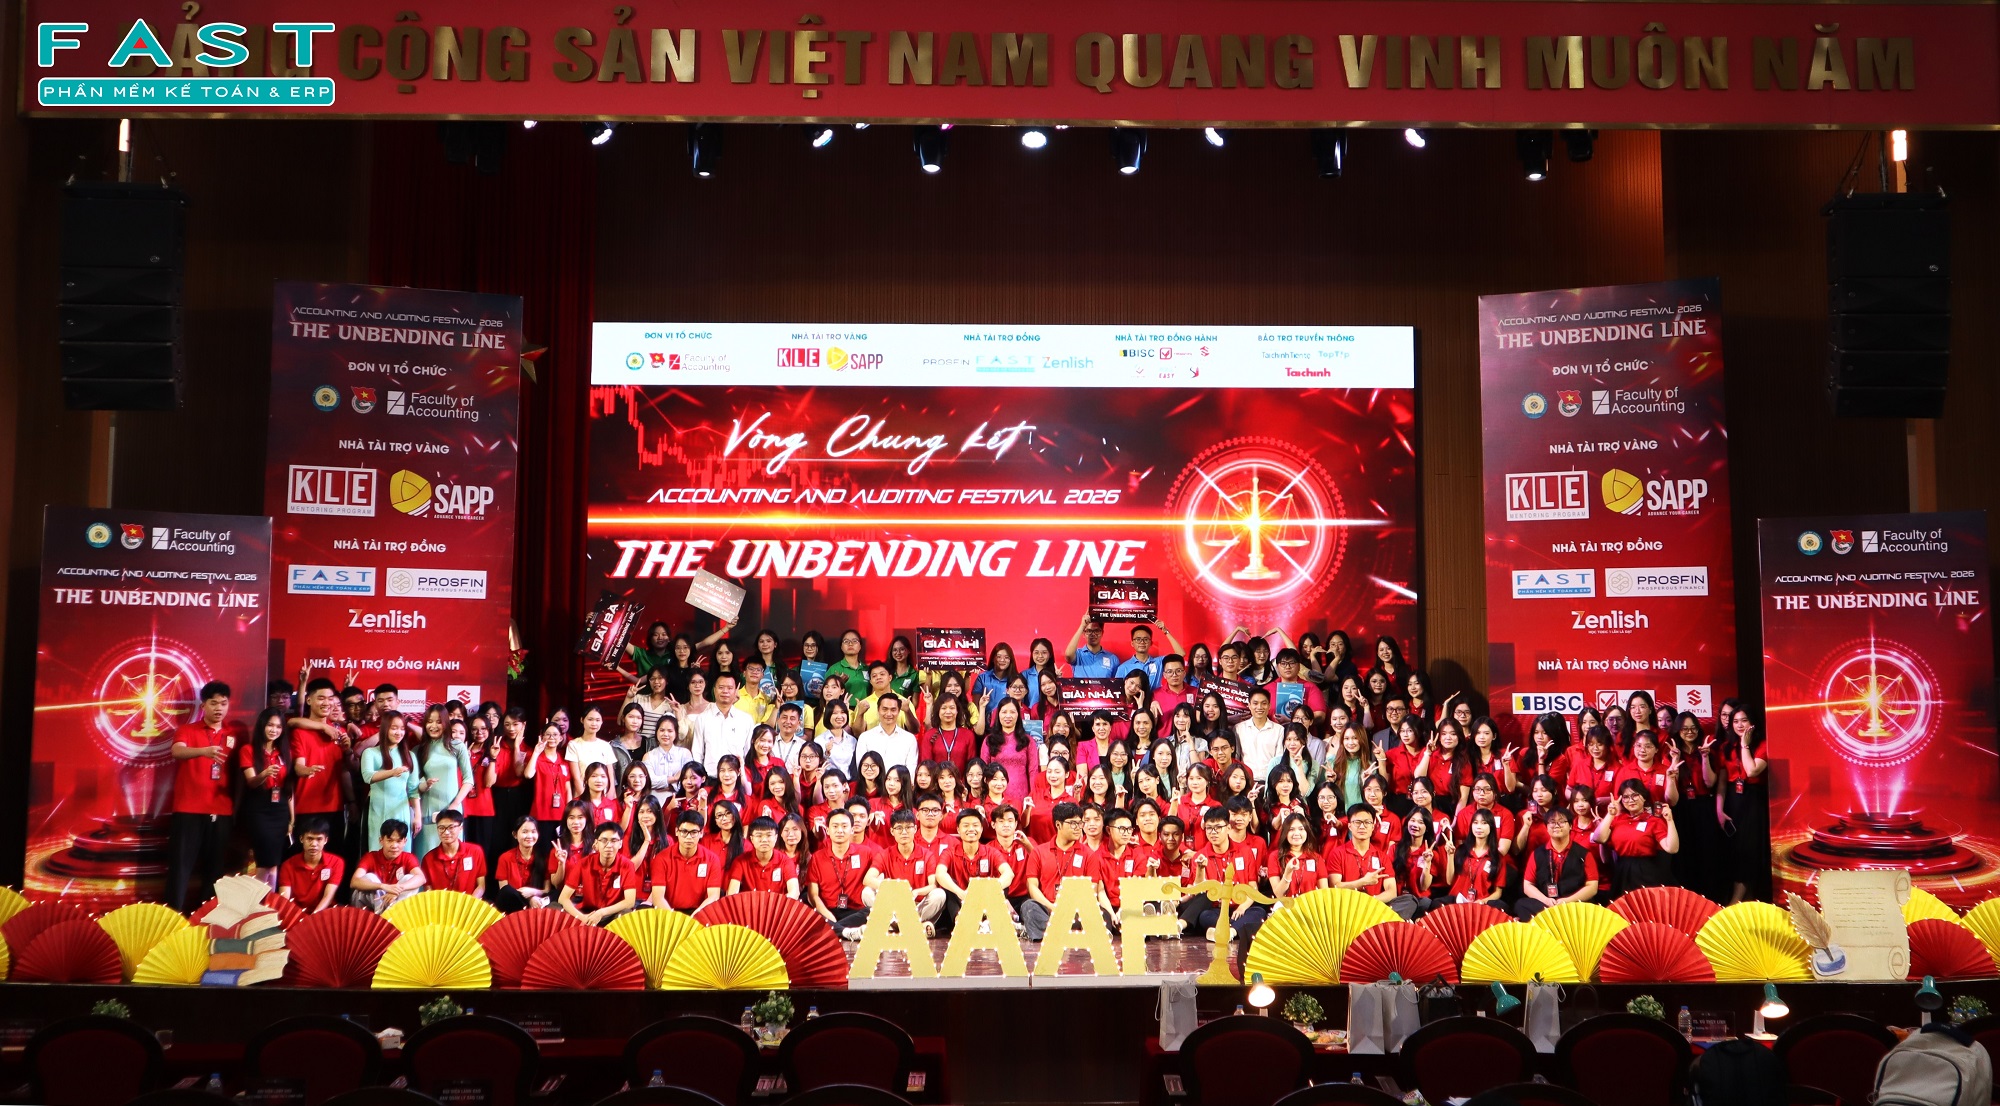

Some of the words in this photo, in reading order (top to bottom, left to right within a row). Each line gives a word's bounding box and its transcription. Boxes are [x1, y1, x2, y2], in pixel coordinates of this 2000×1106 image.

[337, 15, 529, 94] CỘNG
[551, 5, 695, 83] SẢN
[721, 15, 870, 98] VIỆT
[889, 31, 1048, 87] NAM
[1074, 32, 1313, 93] QUANG
[1338, 35, 1500, 89] VINH
[1527, 22, 1728, 89] MUÔN
[1753, 23, 1915, 90] NĂM
[293, 306, 357, 318] ACCOUNTING
[360, 311, 382, 320] AND
[385, 313, 430, 323] AUDITING
[433, 315, 476, 326] FESTIVAL
[479, 319, 503, 328] 2026
[1498, 315, 1557, 327] ACCOUNTING
[1560, 313, 1580, 322] AND
[1583, 310, 1627, 321] AUDITING
[1630, 306, 1674, 317] FESTIVAL
[1677, 305, 1702, 314] 2026
[289, 321, 330, 338] THE
[338, 323, 455, 347] UNBENDING
[462, 332, 506, 349] LINE
[1497, 332, 1533, 349] THE
[1540, 324, 1654, 347] UNBENDING
[1661, 319, 1707, 338] LINE
[777, 348, 820, 367] KLE
[850, 353, 884, 370] SAPP
[1129, 349, 1155, 358] BISC
[348, 361, 375, 372] ĐƠN
[379, 364, 391, 376] VỊ
[393, 360, 409, 374] TỔ
[412, 363, 447, 376] CHỨC
[681, 363, 731, 372] Accounting
[1042, 356, 1094, 369] Zenlish
[1552, 365, 1578, 376] ĐƠN
[1581, 364, 1592, 376] VỊ
[1595, 358, 1611, 373] TỔ
[1614, 359, 1649, 373] CHỨC
[411, 392, 457, 407] Faculty
[461, 396, 474, 407] of
[1615, 388, 1662, 403] Faculty
[1666, 387, 1679, 399] of
[406, 407, 479, 422] Accounting
[1611, 400, 1685, 415] Accounting
[339, 438, 364, 450] NHÀ
[368, 439, 386, 451] TÀI
[389, 441, 412, 455] TRỢ
[416, 440, 450, 454] VÀNG
[723, 411, 807, 474] Vòng
[826, 414, 949, 475] Chung
[961, 420, 1036, 457] kết
[1549, 441, 1574, 454] NHÀ
[1577, 441, 1595, 453] TÀI
[1598, 441, 1620, 455] TRỢ
[1623, 439, 1658, 451] VÀNG
[292, 469, 371, 505] KLE
[1509, 475, 1583, 510] KLE
[1647, 479, 1708, 511] SAPP
[434, 484, 494, 515] SAPP
[646, 489, 791, 504] ACCOUNTING
[792, 489, 846, 504] AND
[849, 489, 957, 504] AUDITING
[958, 489, 1057, 504] FESTIVAL
[1063, 489, 1121, 504] 2026
[290, 505, 334, 514] MENTORING
[174, 528, 215, 542] Faculty
[219, 530, 231, 541] of
[1883, 529, 1927, 542] Faculty
[1930, 528, 1942, 539] of
[169, 541, 235, 555] Accounting
[334, 538, 360, 550] NHÀ
[363, 539, 381, 551] TÀI
[384, 541, 407, 554] TRỢ
[410, 538, 447, 553] ĐỒNG
[1552, 541, 1577, 553] NHÀ
[1580, 540, 1598, 552] TÀI
[1601, 541, 1624, 554] TRỢ
[1626, 536, 1663, 552] ĐỒNG
[1880, 541, 1948, 554] Accounting
[611, 539, 716, 579] THE
[726, 539, 1018, 579] UNBENDING
[1025, 539, 1148, 579] LINE
[57, 568, 119, 577] ACCOUNTING
[122, 569, 143, 578] AND
[146, 570, 189, 579] AUDITING
[191, 571, 232, 581] FESTIVAL
[234, 573, 257, 581] 2026
[293, 569, 372, 583] FAST
[418, 576, 484, 588] PROSFIN
[1517, 573, 1591, 586] FAST
[1637, 575, 1705, 585] PROSFIN
[1775, 575, 1833, 583] ACCOUNTING
[1836, 574, 1856, 582] AND
[1859, 573, 1902, 581] AUDITING
[1904, 571, 1948, 580] FESTIVAL
[1951, 570, 1975, 579] 2026
[54, 588, 93, 604] THE
[100, 590, 211, 607] UNBENDING
[218, 592, 259, 608] LINE
[1129, 591, 1150, 601] BA
[1772, 595, 1810, 610] THE
[1816, 592, 1928, 609] UNBENDING
[1934, 590, 1980, 607] LINE
[348, 608, 426, 629] Zenlish
[603, 604, 619, 624] BA
[1571, 609, 1649, 629] Zenlish
[310, 658, 336, 669] NHÀ
[339, 657, 357, 669] TÀI
[361, 659, 384, 672] TRỢ
[387, 656, 423, 670] ĐỒNG
[426, 658, 460, 670] HÀNH
[1538, 658, 1564, 671] NHÀ
[1566, 658, 1584, 670] TÀI
[1587, 659, 1610, 673] TRỢ
[1612, 655, 1649, 670] ĐỒNG
[1653, 657, 1687, 670] HÀNH
[1534, 695, 1582, 711] BISC
[847, 876, 1182, 979] AAAF
